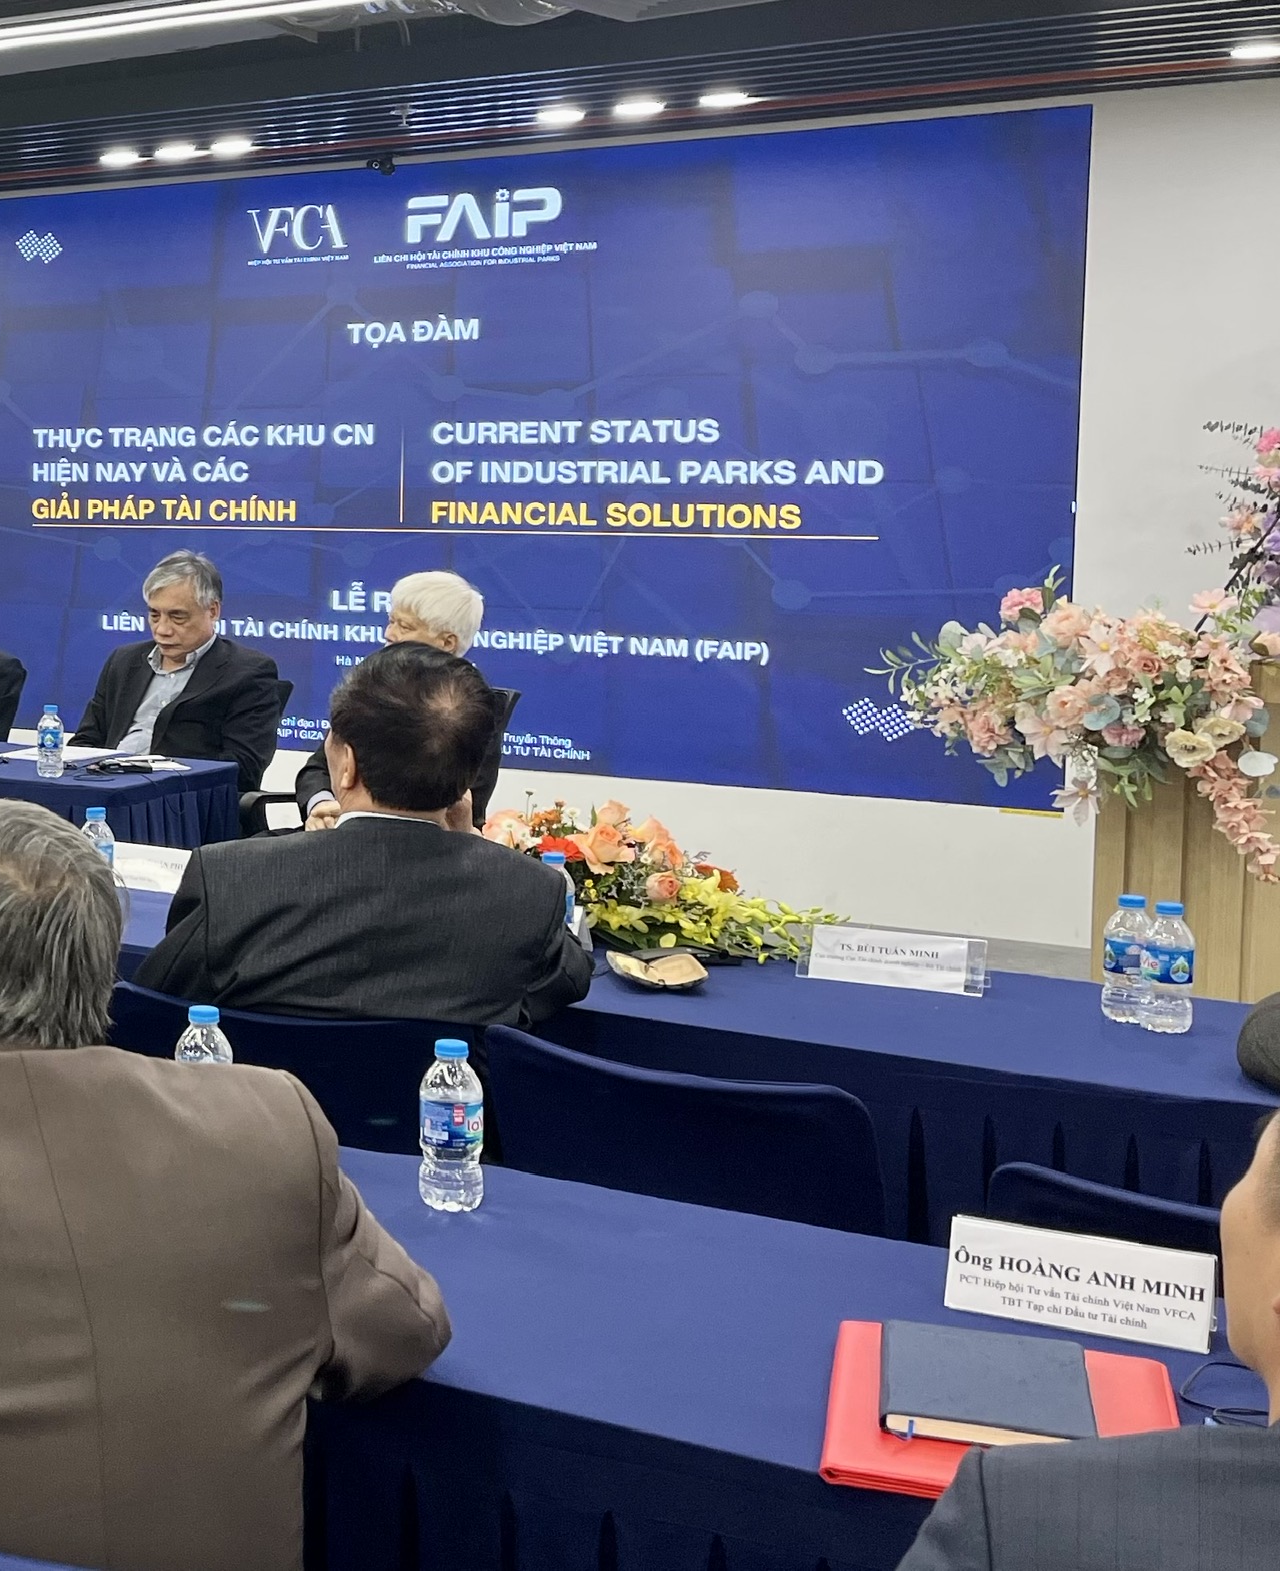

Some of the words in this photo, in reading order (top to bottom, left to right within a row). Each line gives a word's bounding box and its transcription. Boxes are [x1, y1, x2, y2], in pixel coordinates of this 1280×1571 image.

[247, 204, 348, 254] VFCA
[373, 253, 392, 263] LIÊN
[393, 254, 408, 262] CHI
[410, 251, 425, 262] HỘI
[471, 248, 490, 258] KHU
[491, 246, 517, 257] CÔNG
[519, 243, 553, 255] NGHIỆP
[554, 242, 574, 254] VIỆT
[575, 242, 598, 251] NAM
[439, 260, 482, 268] ASSOCIATION
[498, 257, 536, 265] INDUSTRIAL
[537, 255, 560, 263] PARKS
[347, 322, 406, 348] TỌA
[412, 314, 479, 342] ĐÀM
[33, 427, 103, 452] THỰC
[109, 426, 197, 452] TRẠNG
[203, 421, 260, 447] CÁC
[267, 424, 325, 447] KHU
[333, 423, 374, 446] CN
[432, 421, 582, 445] CURRENT
[590, 419, 720, 443] STATUS
[32, 458, 88, 486] HIỆN
[96, 462, 146, 482] NAY
[152, 457, 186, 482] VÀ
[193, 456, 249, 483] CÁC
[432, 460, 473, 484] OF
[481, 460, 671, 485] INDUSTRIAL
[680, 460, 797, 485] PARKS
[804, 460, 885, 485] AND
[32, 492, 80, 520] GIẢI
[87, 495, 155, 520] PHÁP
[161, 495, 201, 521] TÀI
[209, 495, 297, 522] CHÍNH
[430, 500, 597, 526] FINANCIAL
[606, 501, 802, 530] SOLUTIONS
[332, 582, 366, 612] LỄ
[374, 591, 392, 613] R
[102, 612, 145, 632] LIÊN
[231, 617, 264, 637] TÀI
[270, 619, 339, 641] CHÍNH
[473, 628, 564, 655] NGHIỆP
[569, 631, 624, 658] VIỆT
[630, 637, 689, 658] NAM
[695, 639, 769, 666] (FAIP)
[300, 730, 324, 740] GIZA
[539, 735, 571, 749] Thông
[532, 746, 551, 758] TÀI
[553, 748, 590, 760] CHÍNH
[840, 943, 854, 952] TS.
[910, 948, 939, 959] MINH
[955, 1246, 992, 1271] Ông
[999, 1255, 1080, 1282] HOÀNG
[1086, 1271, 1136, 1291] ANH
[1142, 1279, 1206, 1303] MINH
[960, 1274, 981, 1285] PCT
[984, 1278, 1006, 1291] Hiệp
[1009, 1282, 1024, 1293] hội
[1027, 1286, 1041, 1295] Tư
[1043, 1287, 1060, 1299] vấn
[1064, 1291, 1080, 1302] Tài
[1083, 1295, 1109, 1307] chính
[1113, 1299, 1133, 1311] Việt
[1136, 1303, 1160, 1315] Nam
[1163, 1307, 1196, 1321] VFCA
[1001, 1296, 1024, 1307] TBT
[1026, 1301, 1045, 1313] Tạp
[1047, 1304, 1062, 1315] chí
[1065, 1307, 1085, 1319] Đầu
[1088, 1312, 1098, 1321] tư
[1101, 1312, 1117, 1323] Tài
[1120, 1317, 1147, 1329] chính
